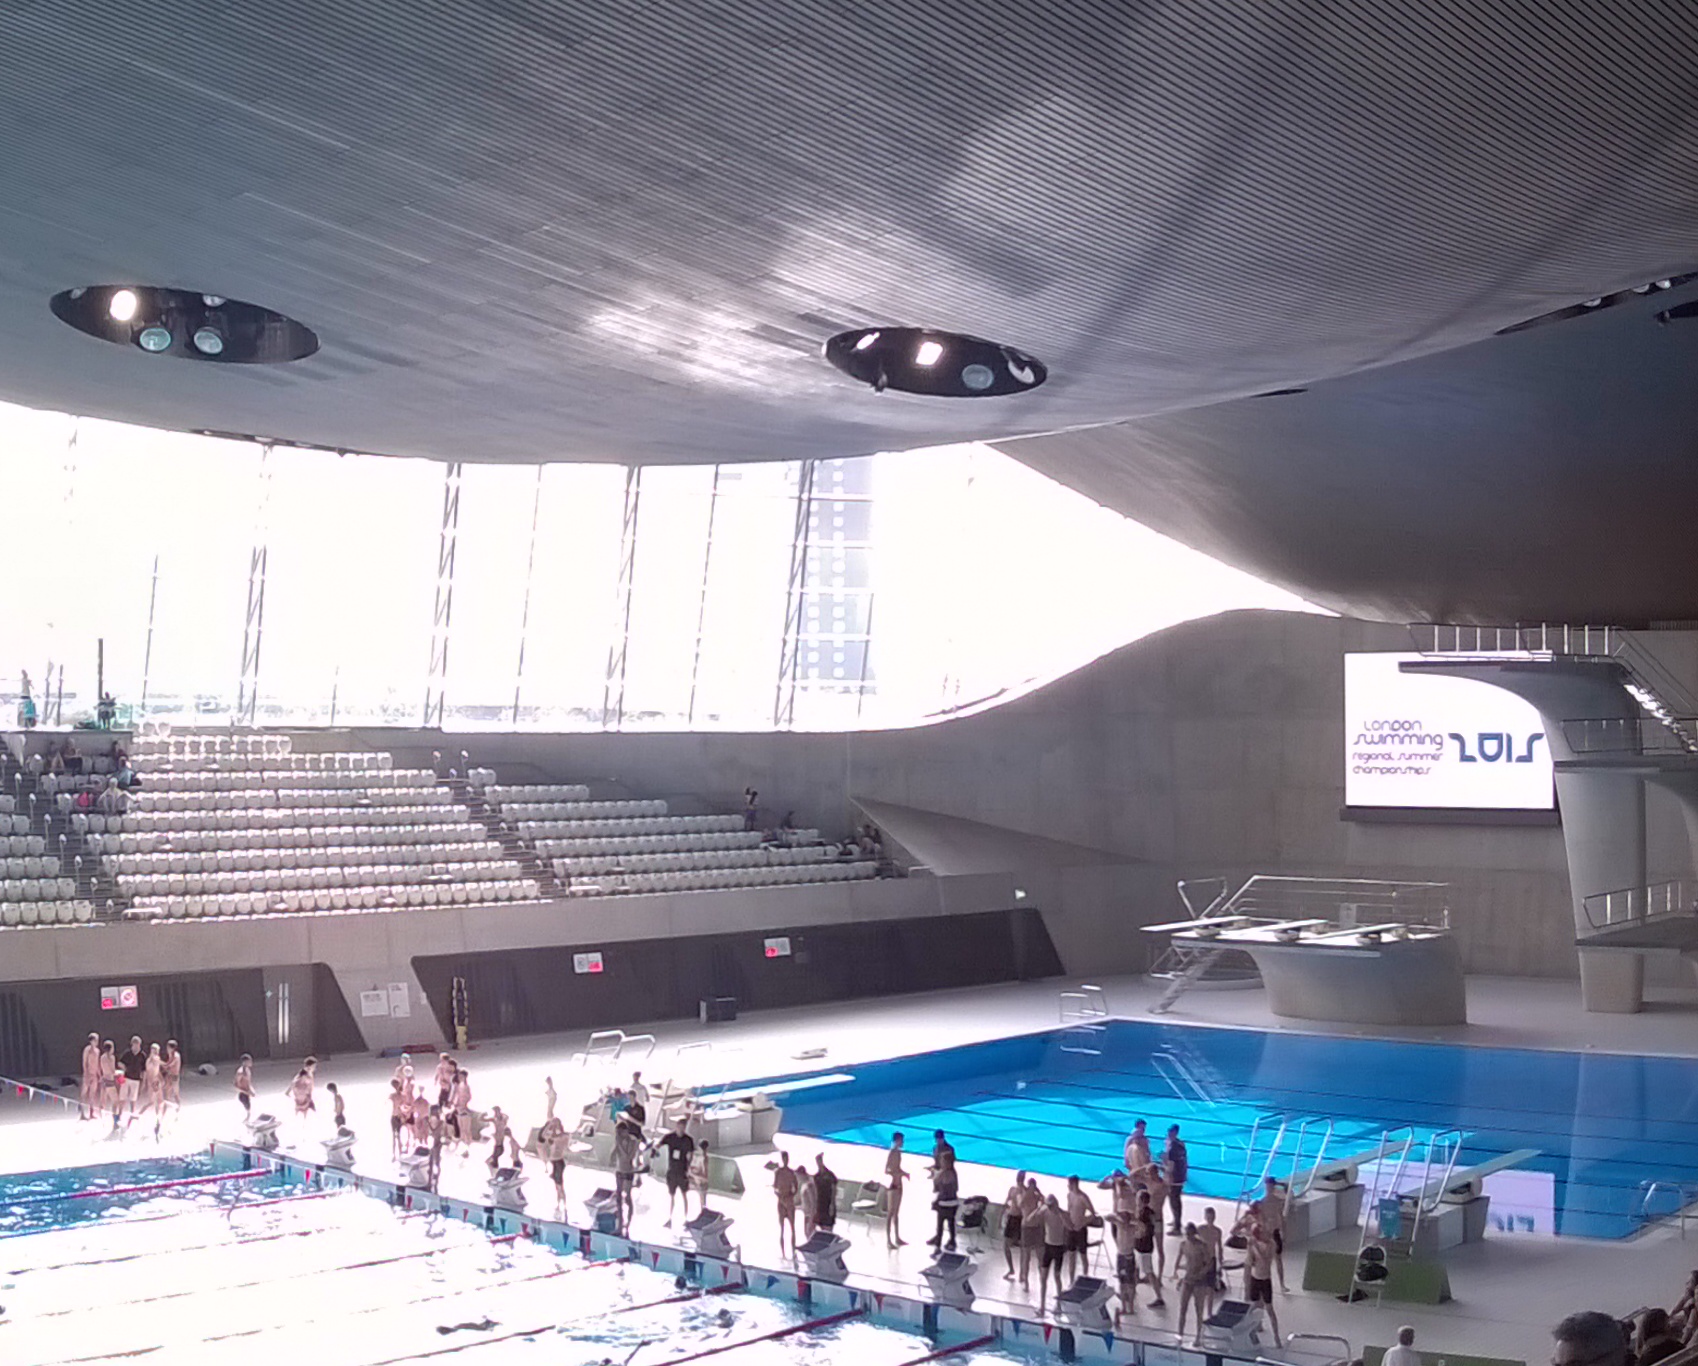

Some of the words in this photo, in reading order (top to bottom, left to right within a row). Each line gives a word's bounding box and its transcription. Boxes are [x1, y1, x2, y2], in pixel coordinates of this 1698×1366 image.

[1353, 733, 1444, 751] swimming
[1448, 732, 1545, 763] 2015
[1352, 751, 1394, 764] regional
[1397, 752, 1444, 761] summer
